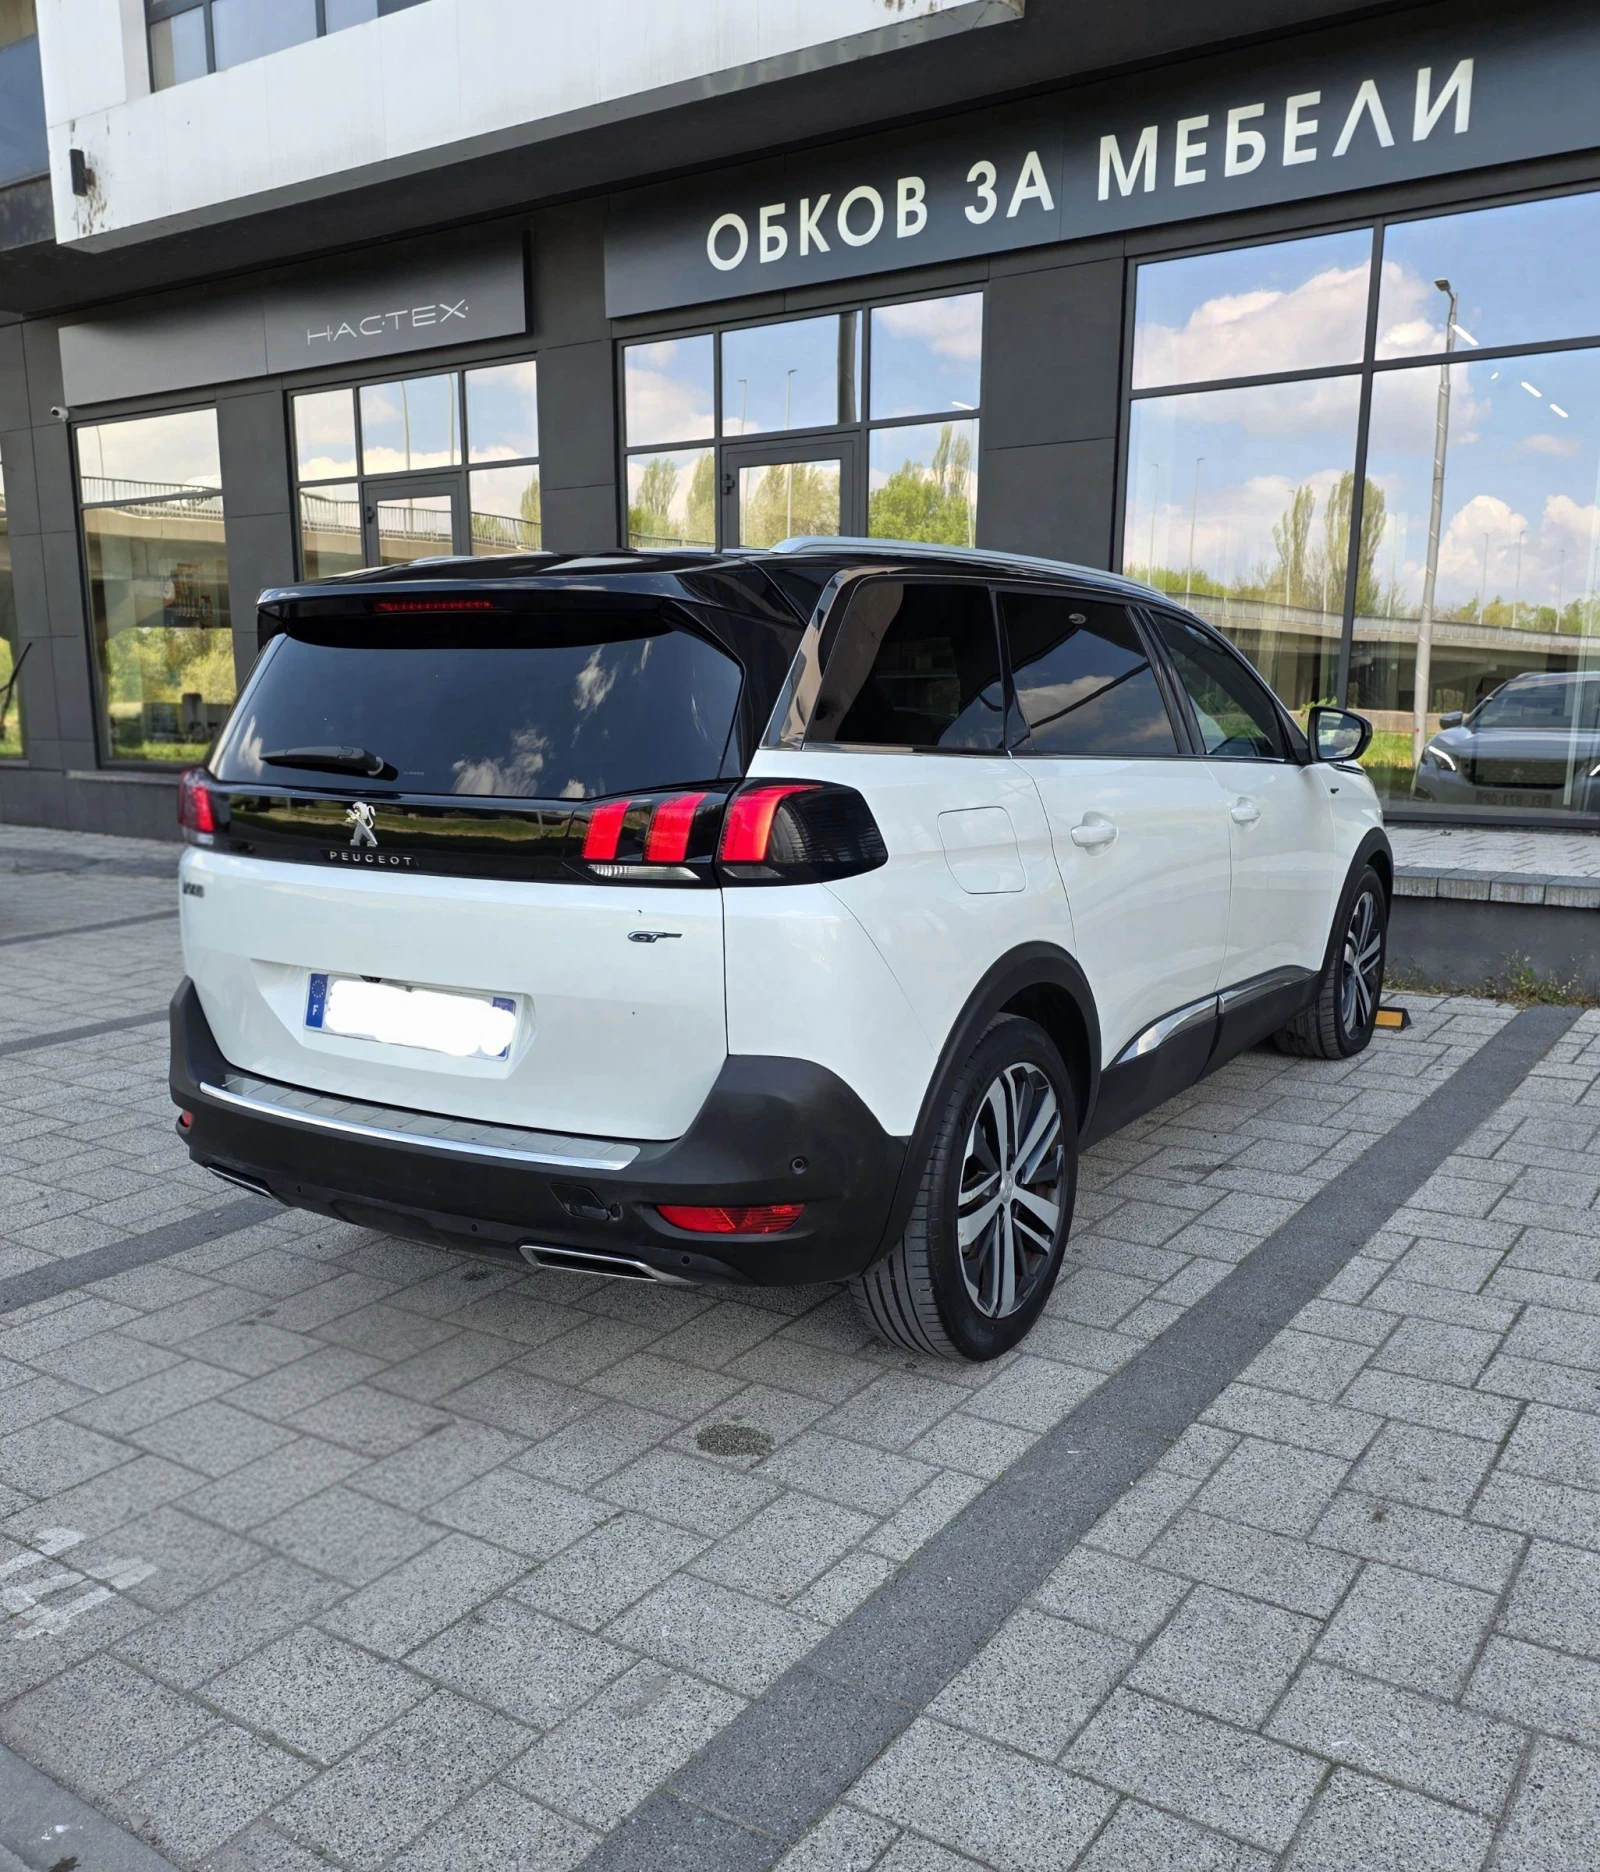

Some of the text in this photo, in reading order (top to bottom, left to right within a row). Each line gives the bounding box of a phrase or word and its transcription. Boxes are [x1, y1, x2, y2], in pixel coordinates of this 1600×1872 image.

[707, 58, 1474, 271] ОБКОВ ЗА МЕБЕЛИ
[329, 851, 412, 866] PEUGEOT
[312, 1004, 319, 1016] F
